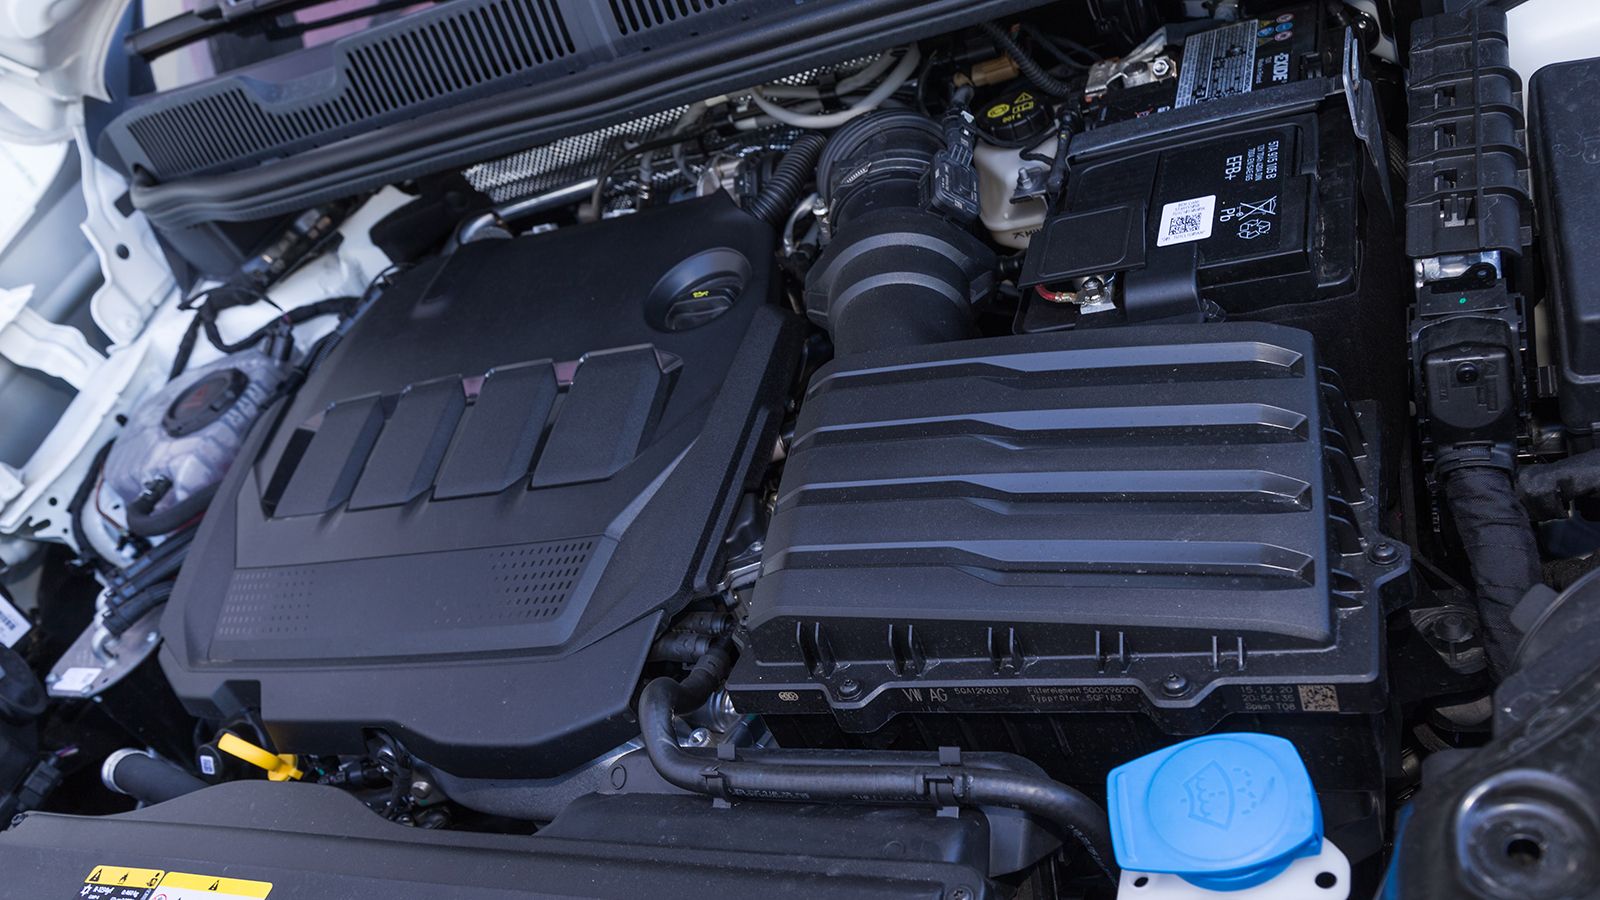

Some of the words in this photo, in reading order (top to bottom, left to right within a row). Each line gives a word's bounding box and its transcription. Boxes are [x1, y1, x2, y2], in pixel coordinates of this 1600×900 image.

[1272, 52, 1289, 81] EXIDE
[1224, 154, 1243, 181] EFB+
[1219, 207, 1236, 222] Pb
[901, 690, 922, 702] VW
[929, 690, 948, 702] AG
